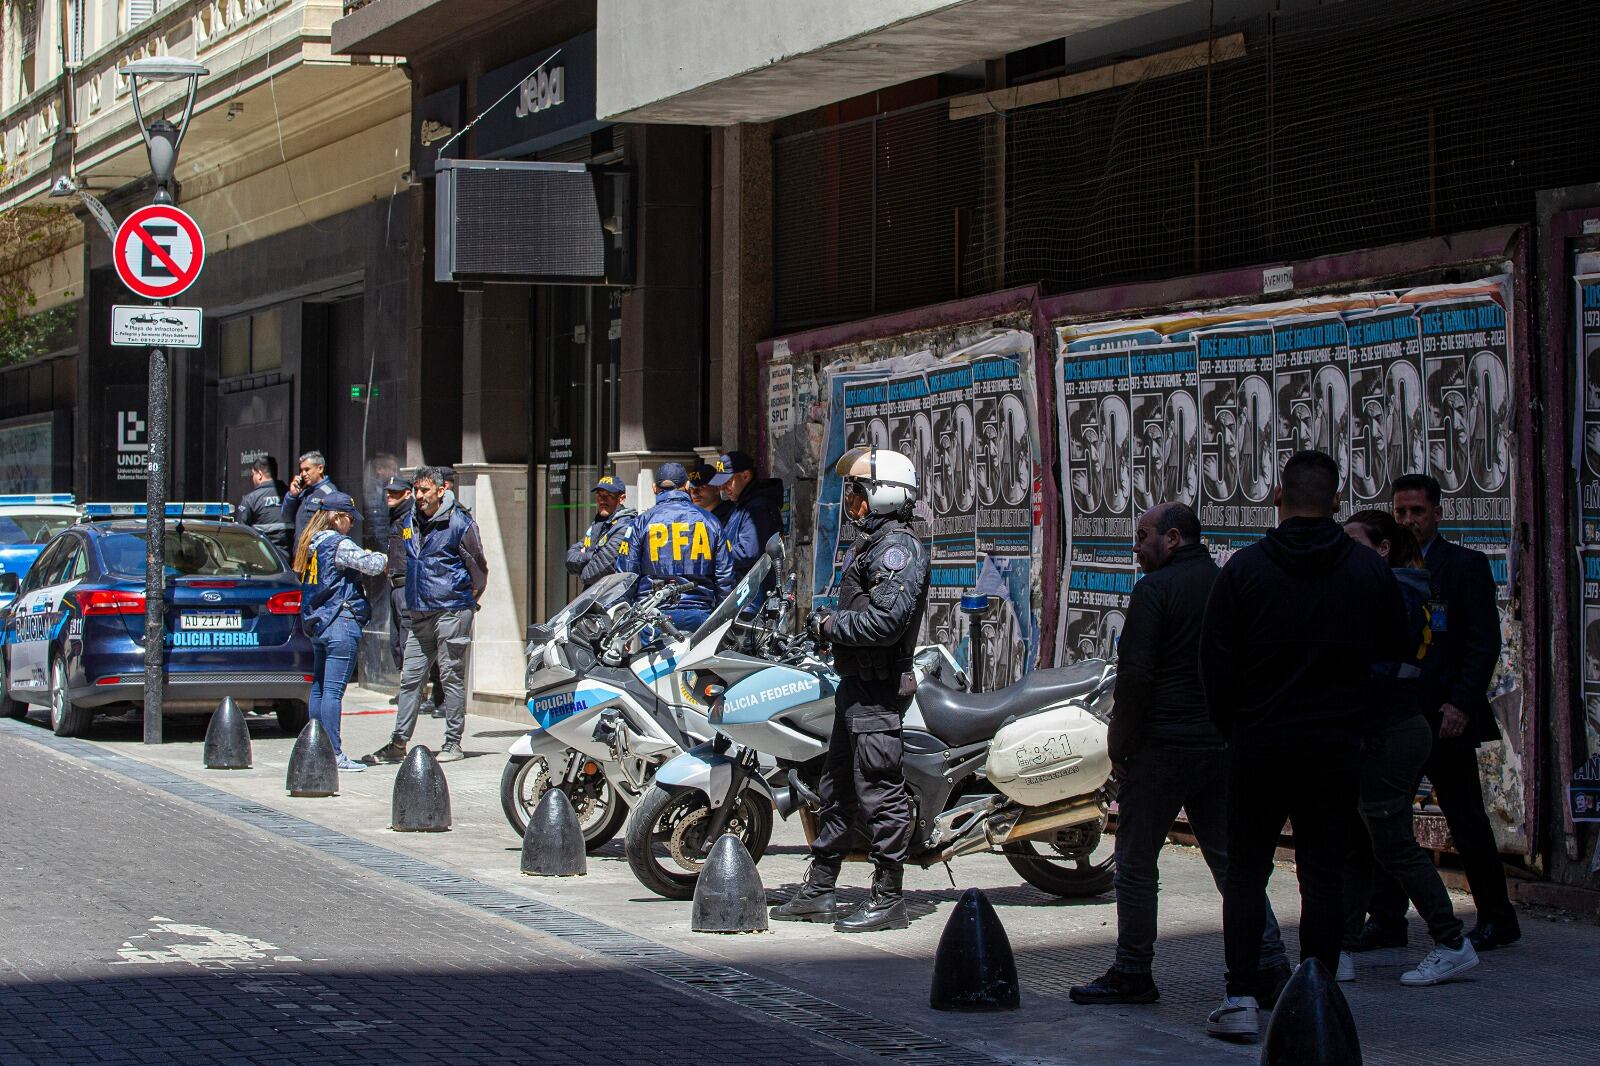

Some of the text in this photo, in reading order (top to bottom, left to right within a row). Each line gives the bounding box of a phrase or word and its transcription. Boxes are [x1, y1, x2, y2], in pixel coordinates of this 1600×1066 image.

[1442, 308, 1477, 332] IGNACIO
[1478, 305, 1506, 329] RUCCI
[1325, 322, 1347, 344] RUCCI
[1219, 338, 1249, 357] IGNACIO
[1250, 335, 1272, 355] RUCCI
[771, 408, 788, 423] SPLIT
[117, 454, 148, 466] UNDE
[1201, 501, 1275, 528] AÑOS SIN JUSTICIA
[1440, 497, 1456, 520] OS
[649, 522, 712, 562] PFA
[185, 616, 240, 627] AD 217 AM
[166, 632, 259, 646] POLICIA FEDERAL
[535, 692, 574, 712] POLICIA
[760, 679, 813, 703] FEDERAL
[550, 699, 588, 719] FEDERAL
